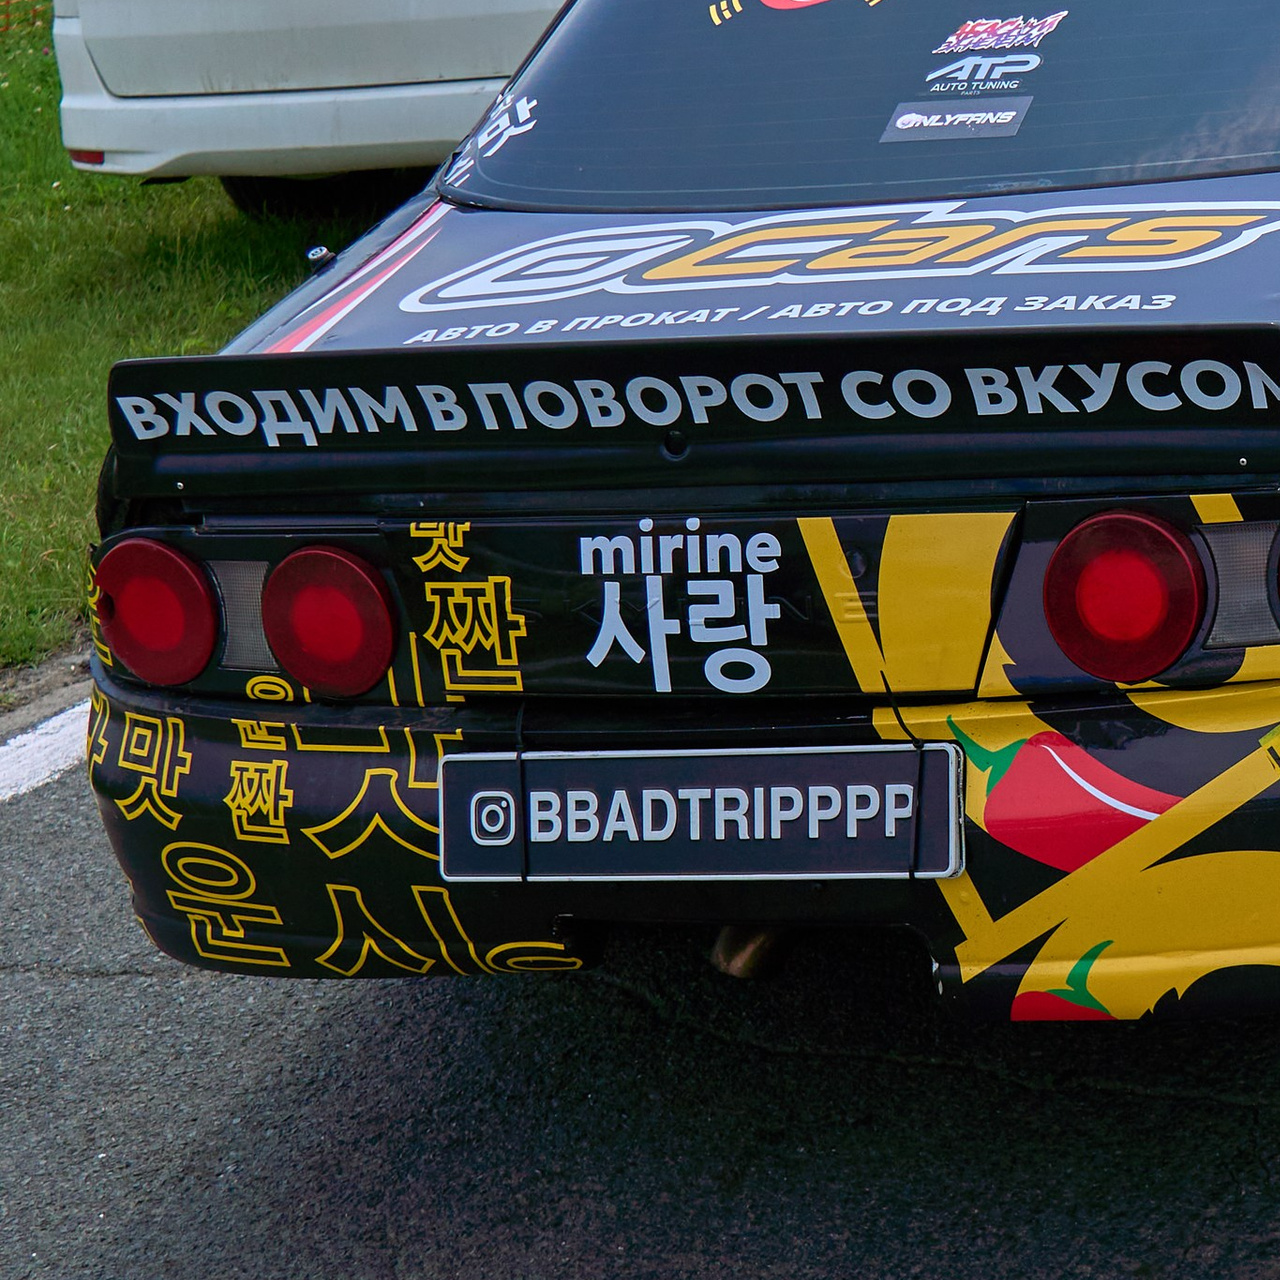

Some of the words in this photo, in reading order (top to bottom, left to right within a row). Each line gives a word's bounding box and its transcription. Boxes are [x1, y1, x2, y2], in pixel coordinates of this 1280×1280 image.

[926, 54, 1042, 82] ATP
[930, 81, 968, 93] AUTO
[971, 80, 1020, 90] TUNING
[404, 316, 517, 344] АВТО
[523, 312, 564, 335] В
[570, 307, 740, 333] ПРОКАТ
[767, 298, 893, 322] АВТО
[900, 296, 1005, 320] ПОД
[1006, 292, 1178, 313] ЗАКАЗ
[115, 386, 419, 448] ВХОДИМ
[417, 383, 469, 432] В
[467, 370, 825, 432] ПОВОРОТ
[841, 365, 955, 423] СО
[580, 518, 782, 575] mirine
[586, 574, 782, 694] 사랑
[530, 783, 917, 844] BBADTRIPPPP
